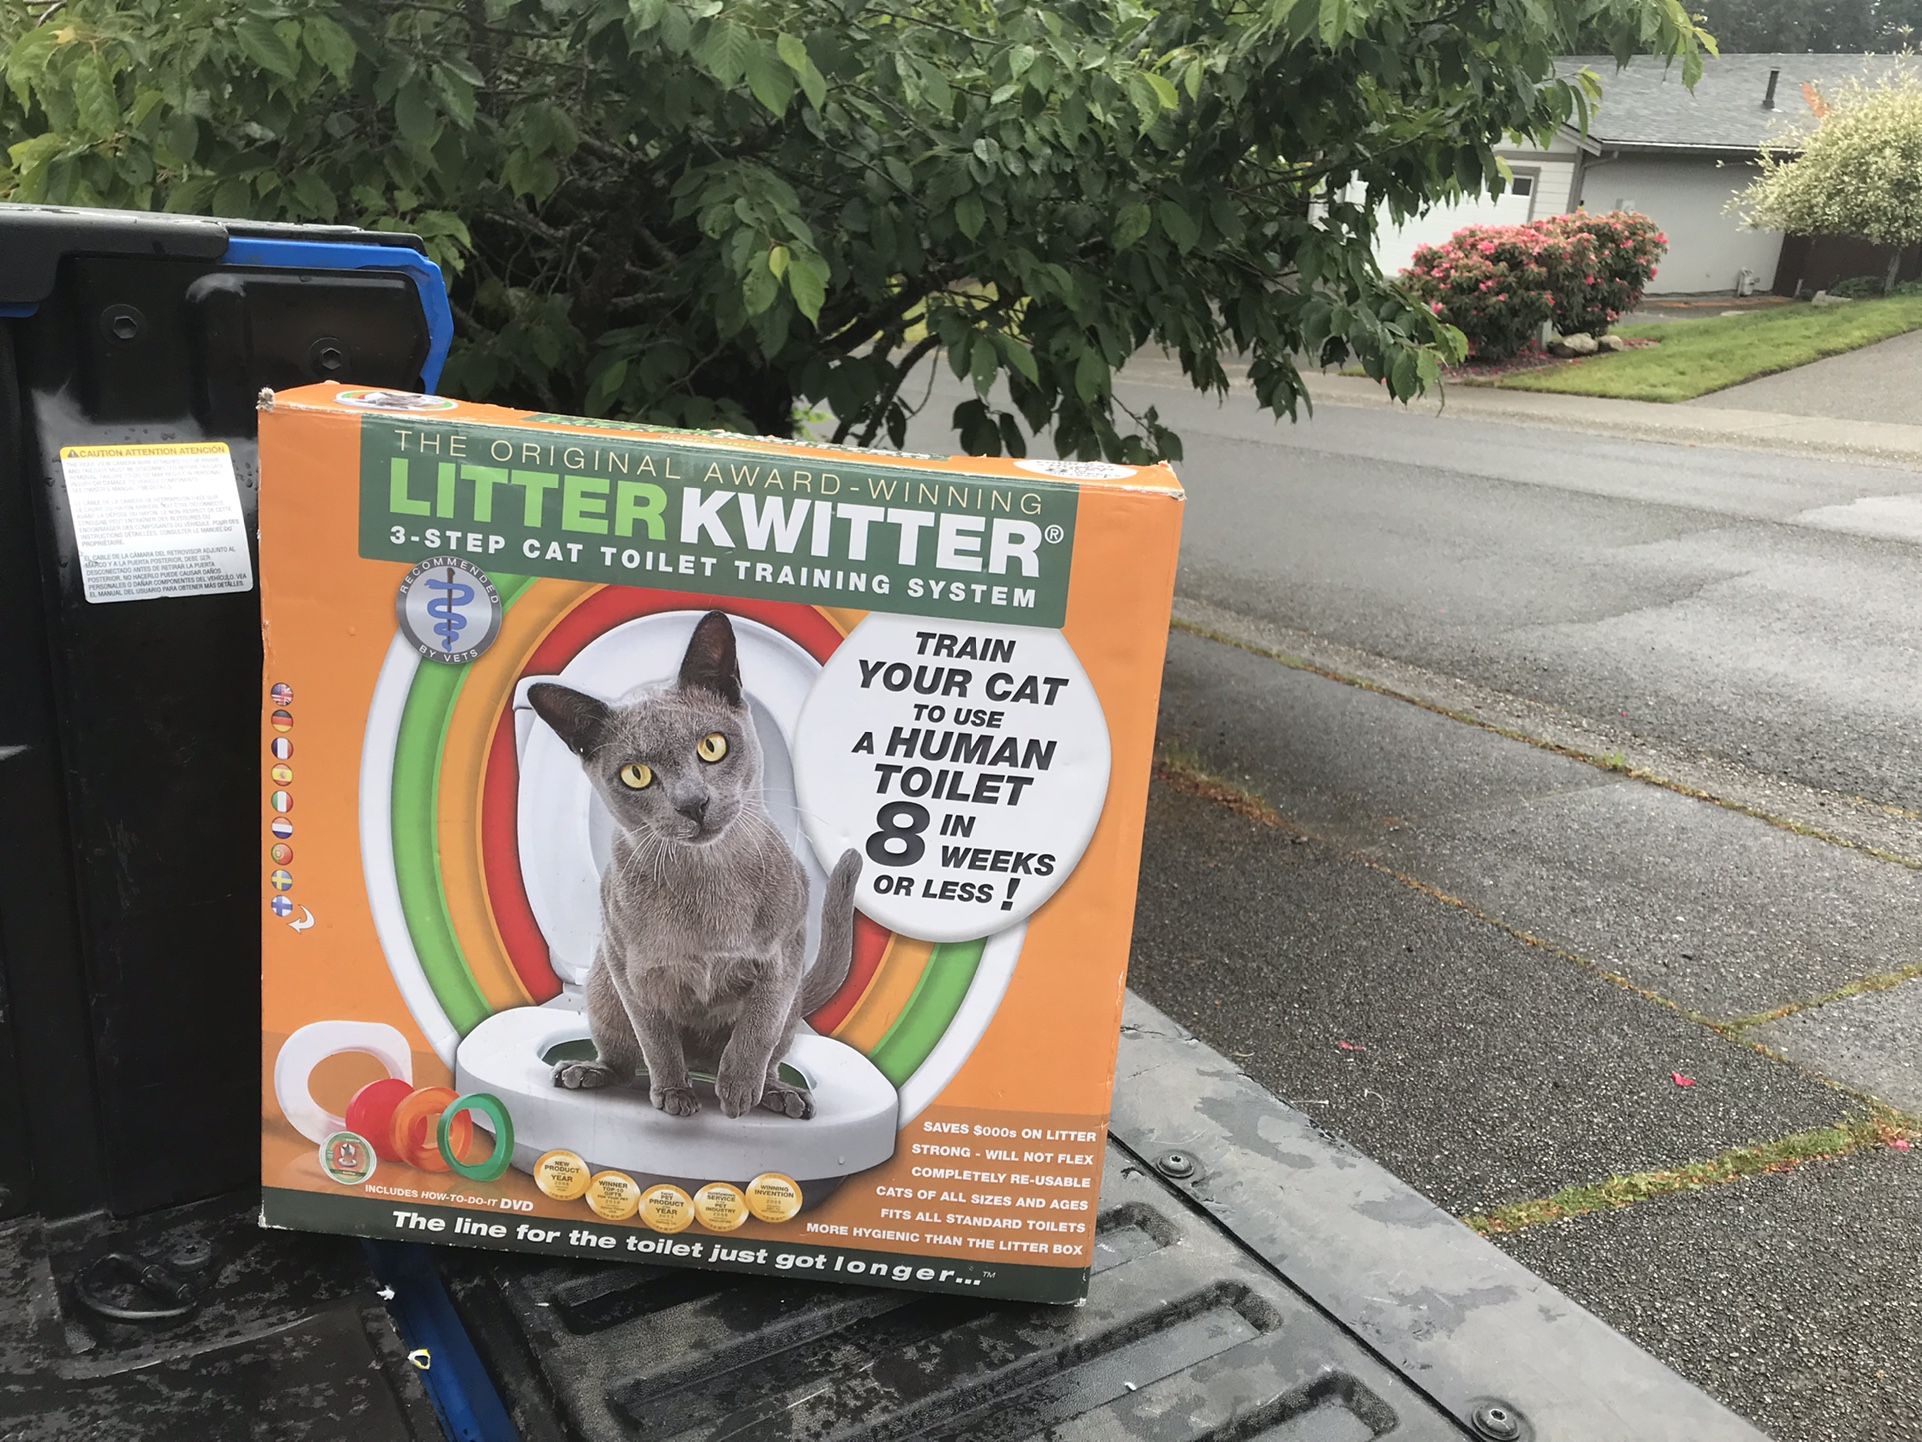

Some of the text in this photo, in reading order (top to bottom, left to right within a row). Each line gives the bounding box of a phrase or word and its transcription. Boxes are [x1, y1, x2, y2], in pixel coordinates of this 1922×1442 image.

[80, 449, 123, 458] CAUTION
[125, 447, 177, 457] ATTENTION
[395, 430, 468, 458] THE
[491, 440, 681, 480] ORIGINAL
[704, 462, 1041, 515] AWARD-WINNING
[389, 457, 668, 541] LITTER
[390, 525, 1036, 609] 3-STEP CAT TOILET TRAINING SYSTEM
[400, 558, 499, 604] RECOMMENDED
[419, 644, 478, 662] BY VETS
[916, 631, 1016, 663] TRAIN
[858, 659, 1069, 706] YOUR CAT
[913, 703, 1005, 729] TO USE
[851, 726, 1057, 771] A HUMAN
[874, 763, 1034, 806] TOILET
[865, 801, 976, 867] 8 IN
[941, 845, 1055, 877] WEEKS
[873, 874, 915, 896] OR
[923, 1121, 970, 1136] SAVES
[1021, 1127, 1042, 1140] ON
[1046, 1128, 1097, 1143] LITTER
[911, 1143, 971, 1158] STRONG
[985, 1149, 1020, 1163] WILL
[1023, 1151, 1054, 1164] NOT
[1058, 1152, 1094, 1166] FLEX
[544, 1164, 580, 1174] PRODUCT
[551, 1174, 573, 1182] YEAR
[911, 1166, 1091, 1189] COMPLETELY RE-USABLE
[599, 1180, 628, 1189] WINNER
[755, 1189, 794, 1198] INVENTION
[365, 1184, 534, 1212] INCLUDES HOW-TO-DO-IT DVD
[649, 1199, 684, 1207] PRODUCT
[876, 1185, 1089, 1211] CATS OF ALL SIZES AND AGES
[881, 1208, 1086, 1233] FITS ALL STANDARD TOILETS
[393, 1211, 446, 1232] The
[454, 1217, 507, 1238] line
[516, 1224, 561, 1244] for
[568, 1230, 617, 1250] the
[626, 1235, 703, 1258] toilet
[708, 1244, 768, 1265] just
[774, 1253, 828, 1271] got
[806, 1223, 1083, 1257] MORE HYGIENIC THAN THE LITTER BOX
